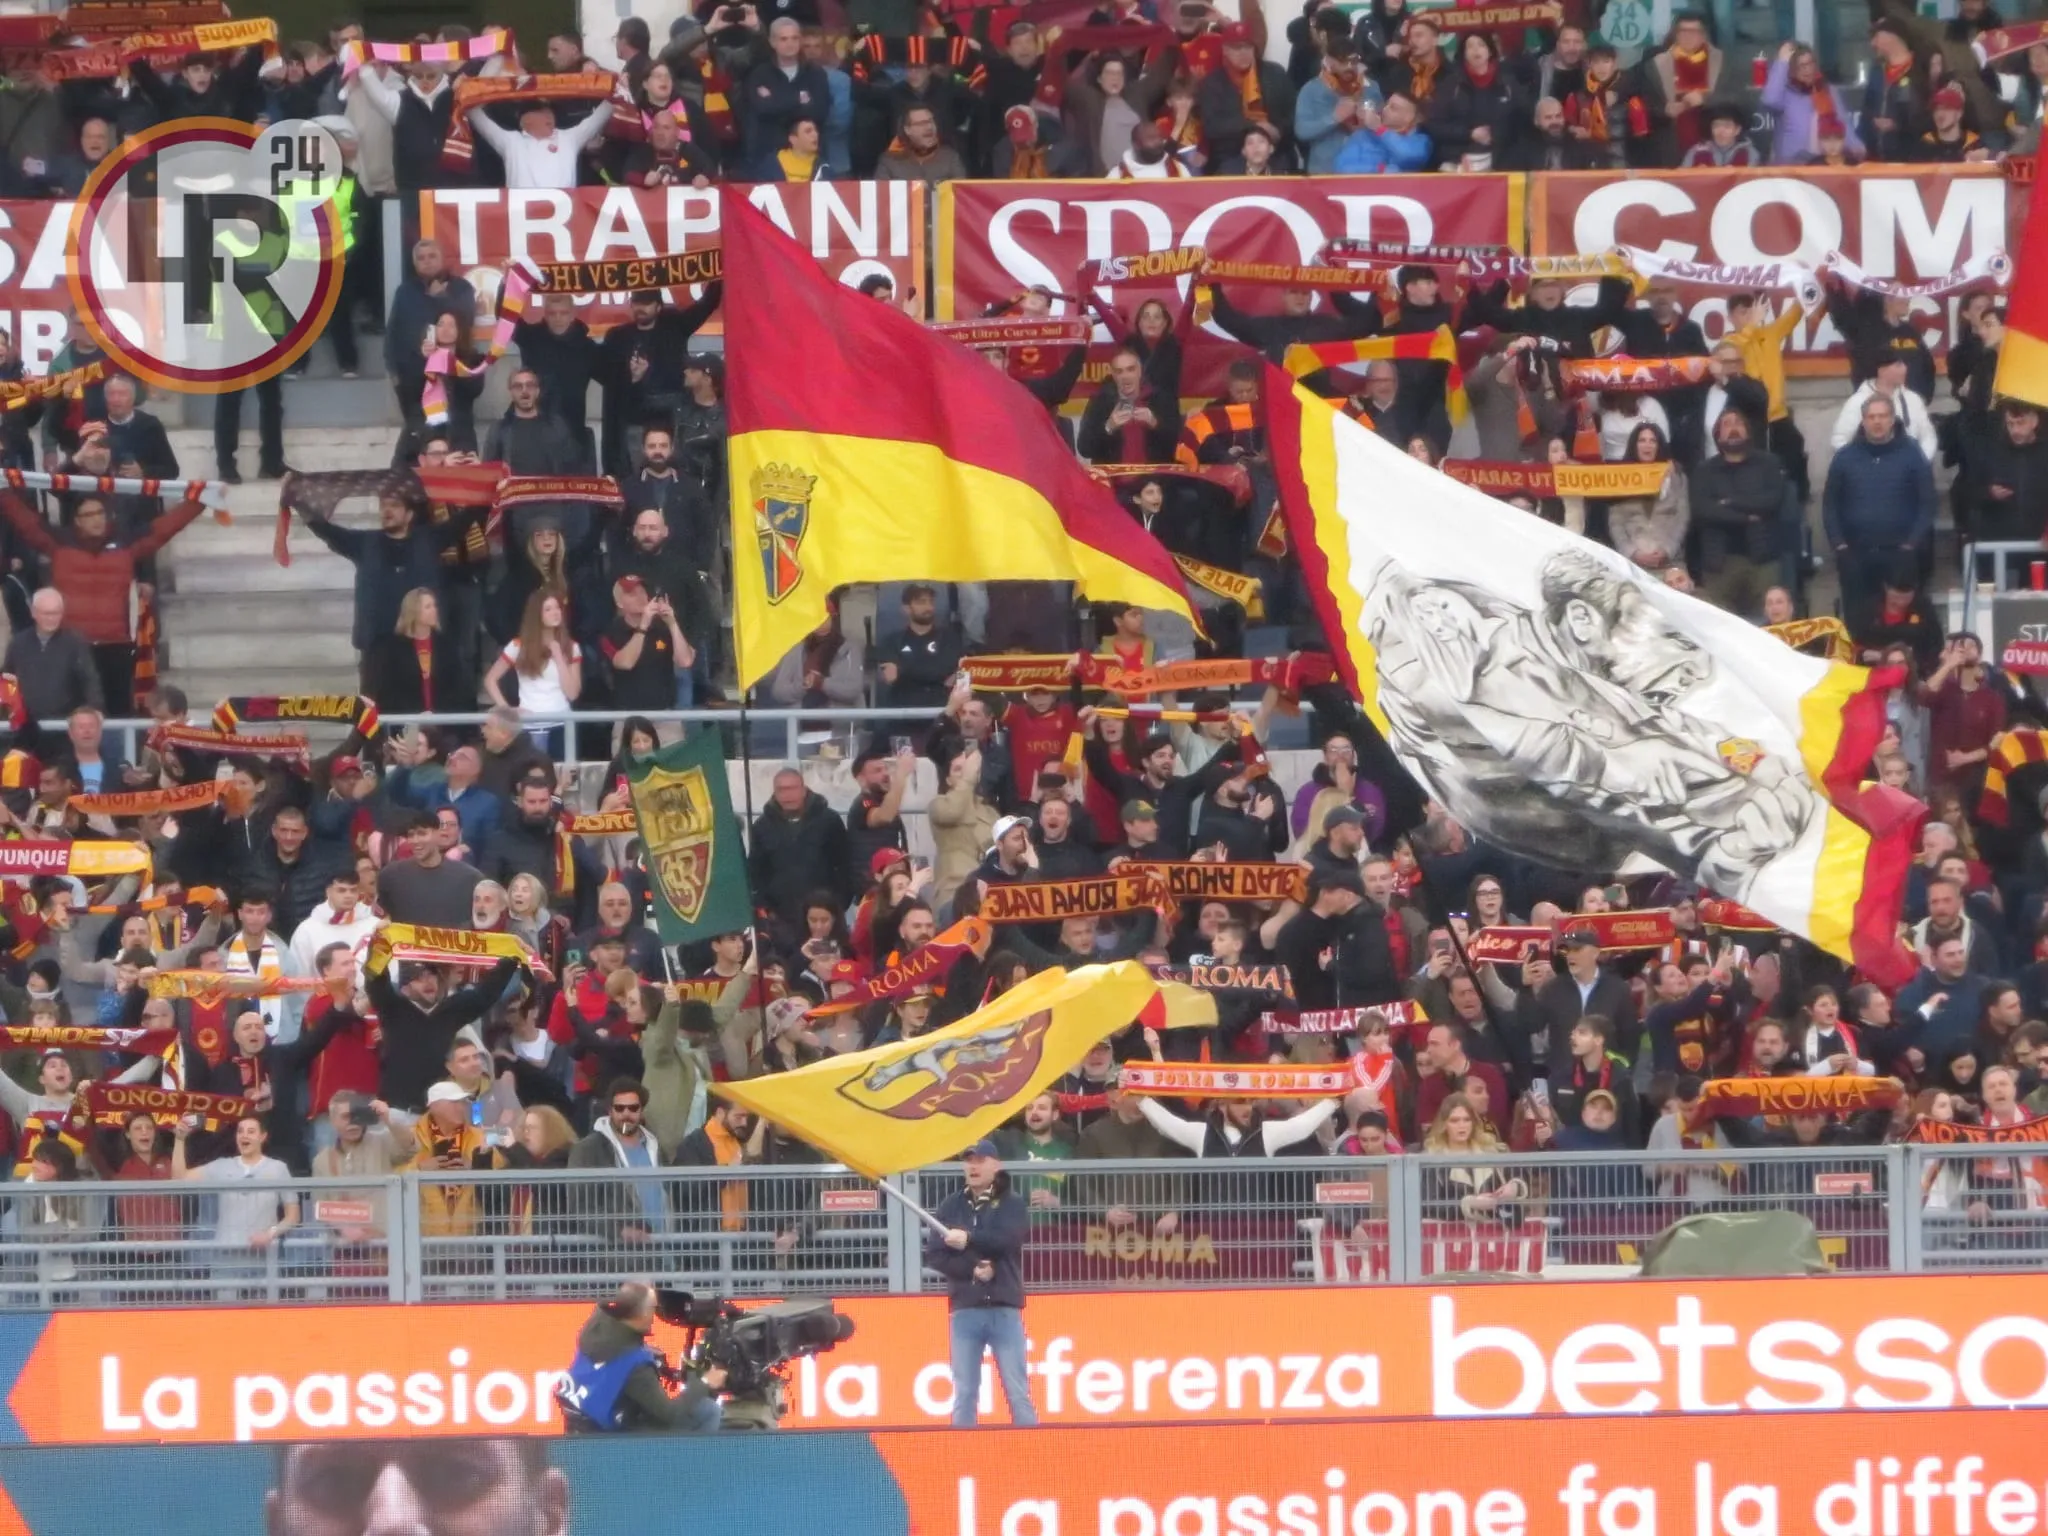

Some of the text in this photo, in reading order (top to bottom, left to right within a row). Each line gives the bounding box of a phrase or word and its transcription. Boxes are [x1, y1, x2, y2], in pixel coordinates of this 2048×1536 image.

[588, 264, 618, 288] VE
[626, 264, 656, 287] SE
[1296, 264, 1354, 283] INSIEME
[278, 696, 354, 717] ROMA
[0, 849, 67, 869] UNQUE
[868, 951, 939, 998] ROMA
[1191, 965, 1281, 990] ROMA
[1330, 1009, 1352, 1031] LA
[1153, 1072, 1310, 1088] FORZA ROMA
[1751, 1080, 1868, 1110] ROMA
[1085, 1225, 1218, 1264] ROMA
[1431, 1294, 2048, 1416] betsso
[101, 1355, 197, 1431] La
[800, 1353, 879, 1417] la
[912, 1337, 1381, 1416] diferenza
[1099, 1466, 1528, 1536] passione
[1558, 1463, 1656, 1536] fa
[1695, 1460, 1778, 1536] la
